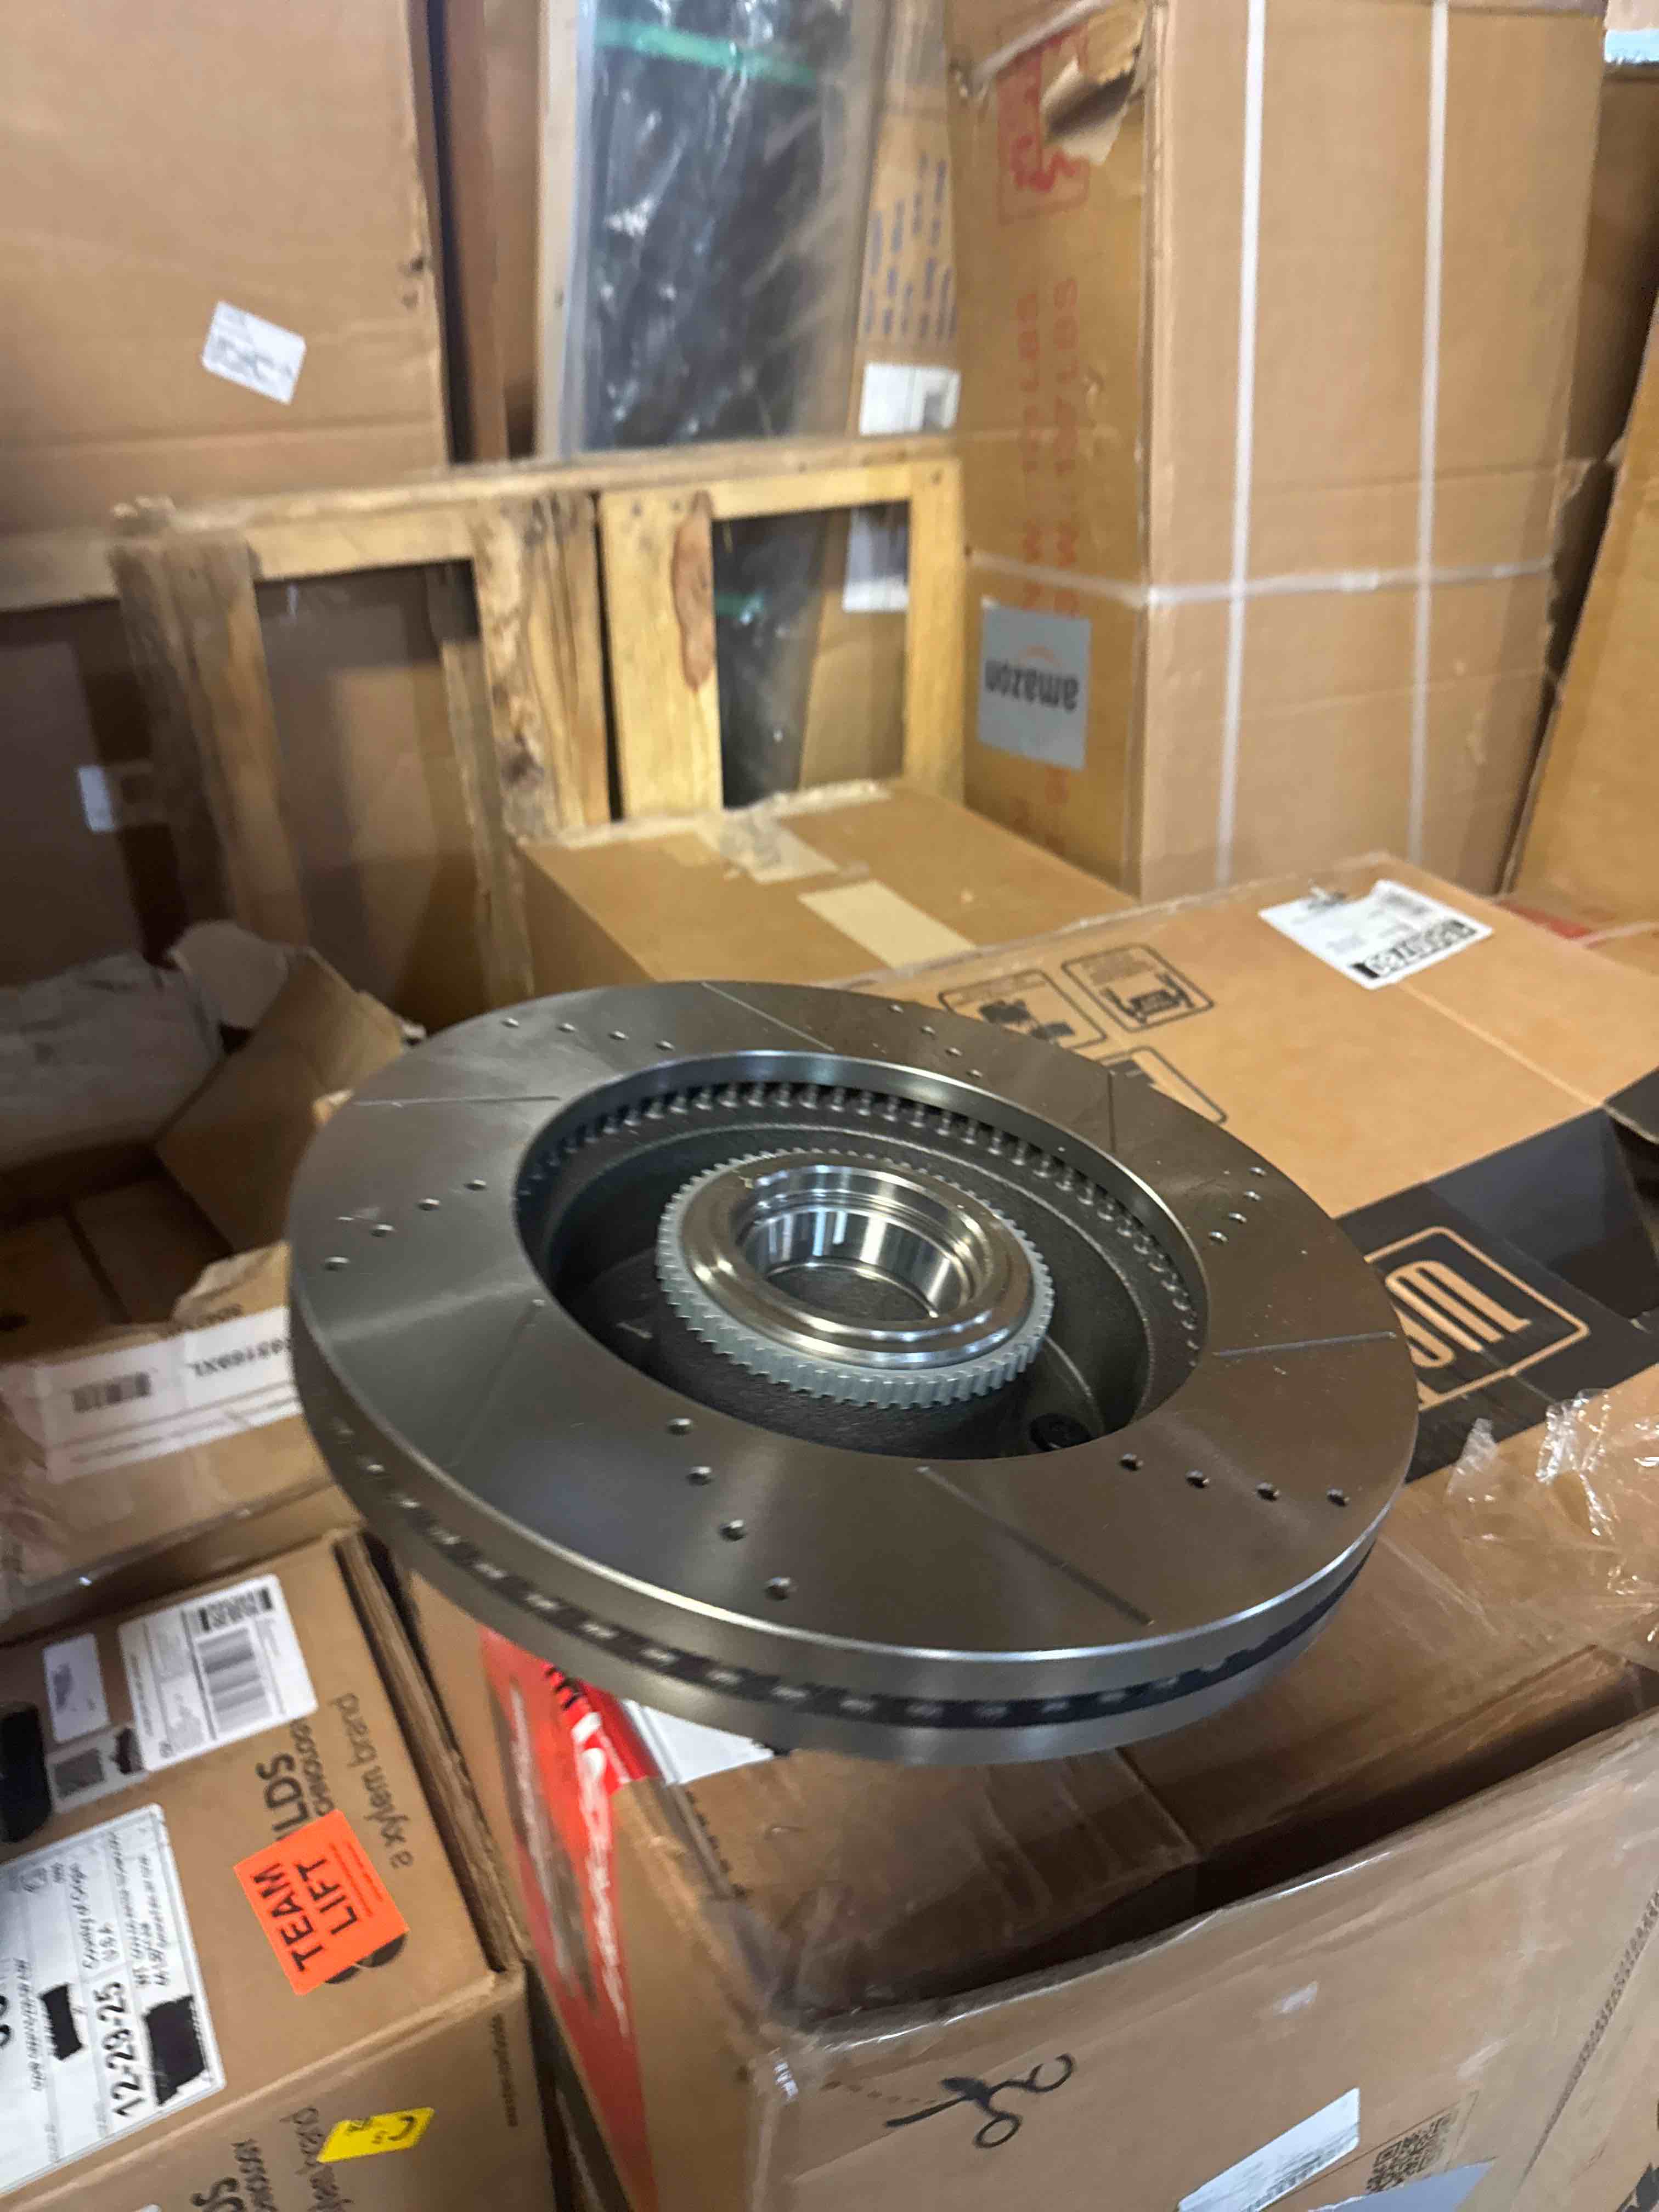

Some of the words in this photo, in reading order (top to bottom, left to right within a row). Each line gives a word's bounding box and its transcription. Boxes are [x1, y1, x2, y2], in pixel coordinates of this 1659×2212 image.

[332, 1692, 377, 1768] brand
[255, 1752, 312, 1841] LDS
[250, 1861, 324, 1973] TEAM
[296, 1858, 359, 1936] LIFT
[92, 1981, 146, 2117] 12-29-25
